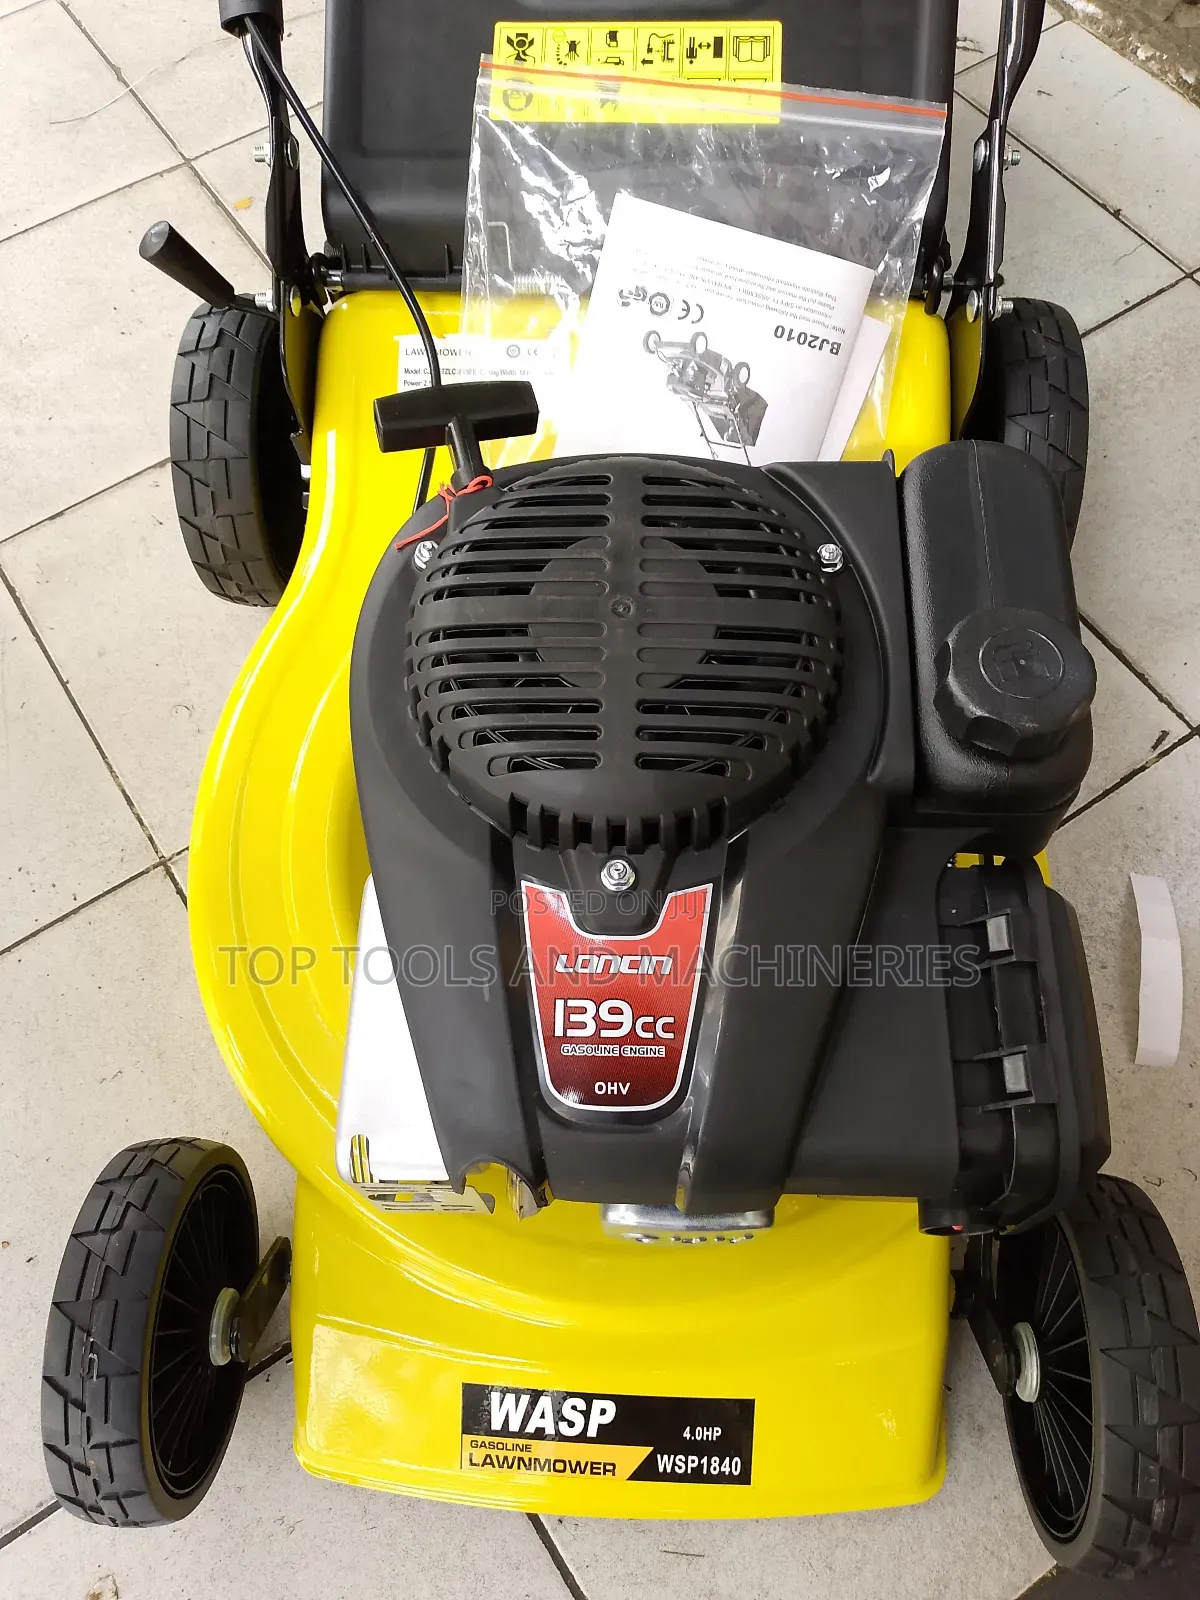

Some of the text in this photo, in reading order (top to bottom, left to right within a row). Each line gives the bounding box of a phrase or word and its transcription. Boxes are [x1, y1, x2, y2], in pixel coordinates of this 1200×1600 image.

[774, 324, 842, 356] BJ2010
[405, 348, 472, 356] LAWMOWER
[560, 1045, 666, 1057] GASOLINE ENGINE
[594, 1082, 630, 1095] OHV
[490, 1391, 617, 1438] WASP
[682, 1426, 722, 1441] 4.0HP
[470, 1439, 532, 1453] GASOLINE
[469, 1452, 616, 1476] LAWNMOWER
[657, 1454, 741, 1476] WSP1840
